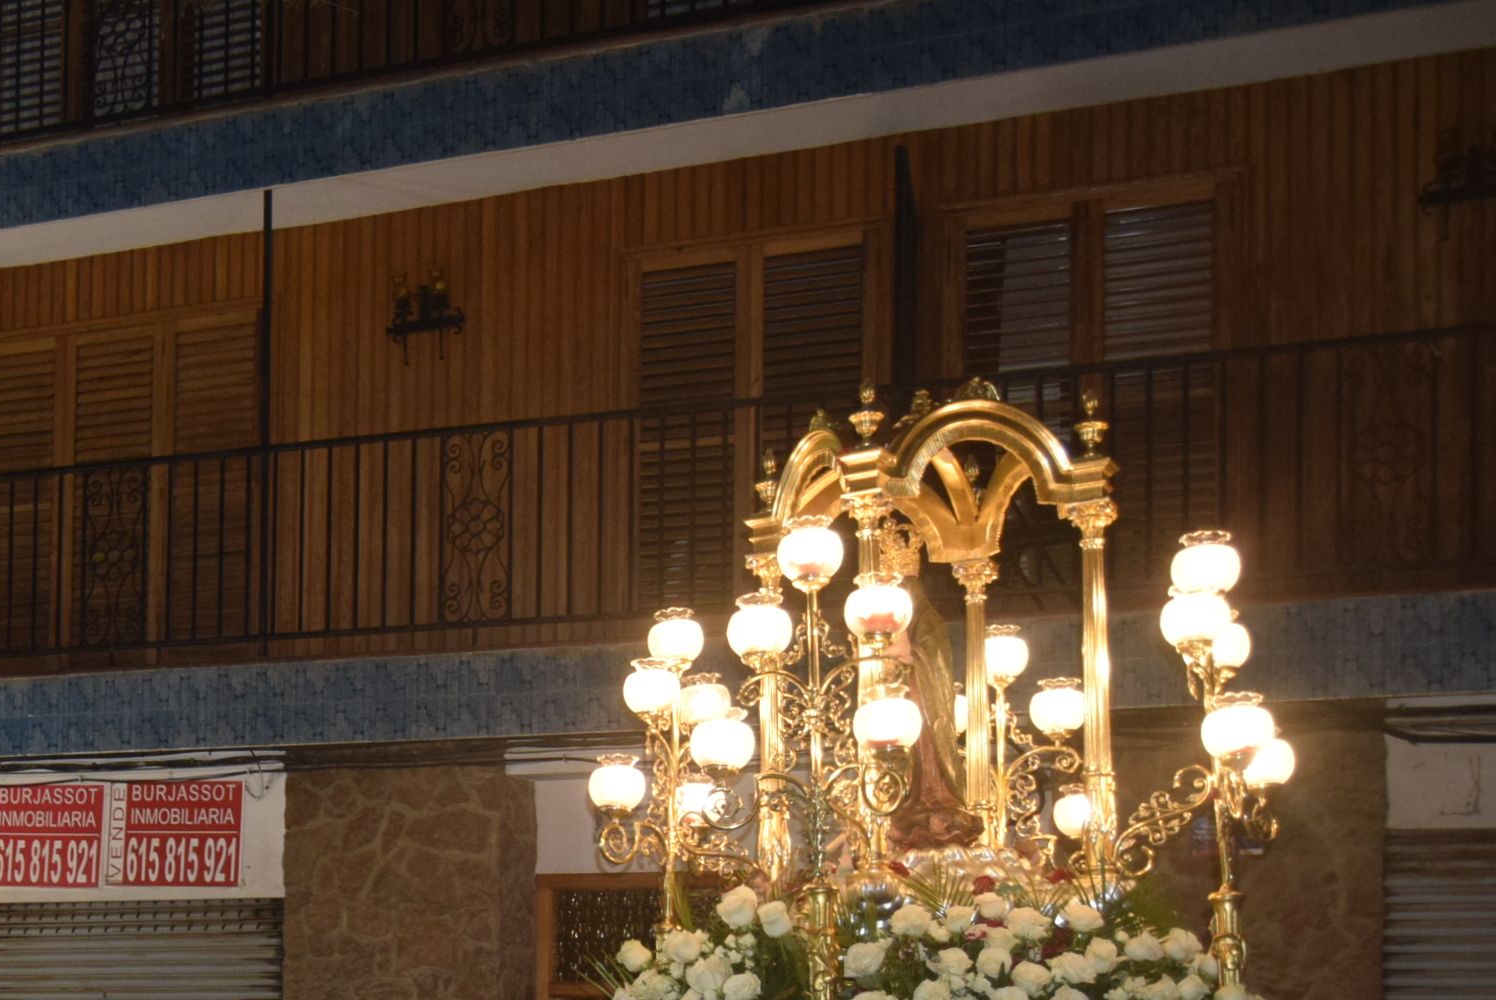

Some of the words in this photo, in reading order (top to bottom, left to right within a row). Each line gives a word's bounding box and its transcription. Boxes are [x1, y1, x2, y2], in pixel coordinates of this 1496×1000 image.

[0, 787, 98, 805] BURJASSOT
[131, 784, 236, 802] BURJASSOT
[108, 785, 126, 878] VENDE
[130, 807, 235, 825] INMOBILIARIA
[29, 839, 62, 884] 815
[66, 839, 98, 884] 921
[126, 837, 160, 882] 615
[165, 837, 199, 882] 815
[203, 837, 236, 883] 921
